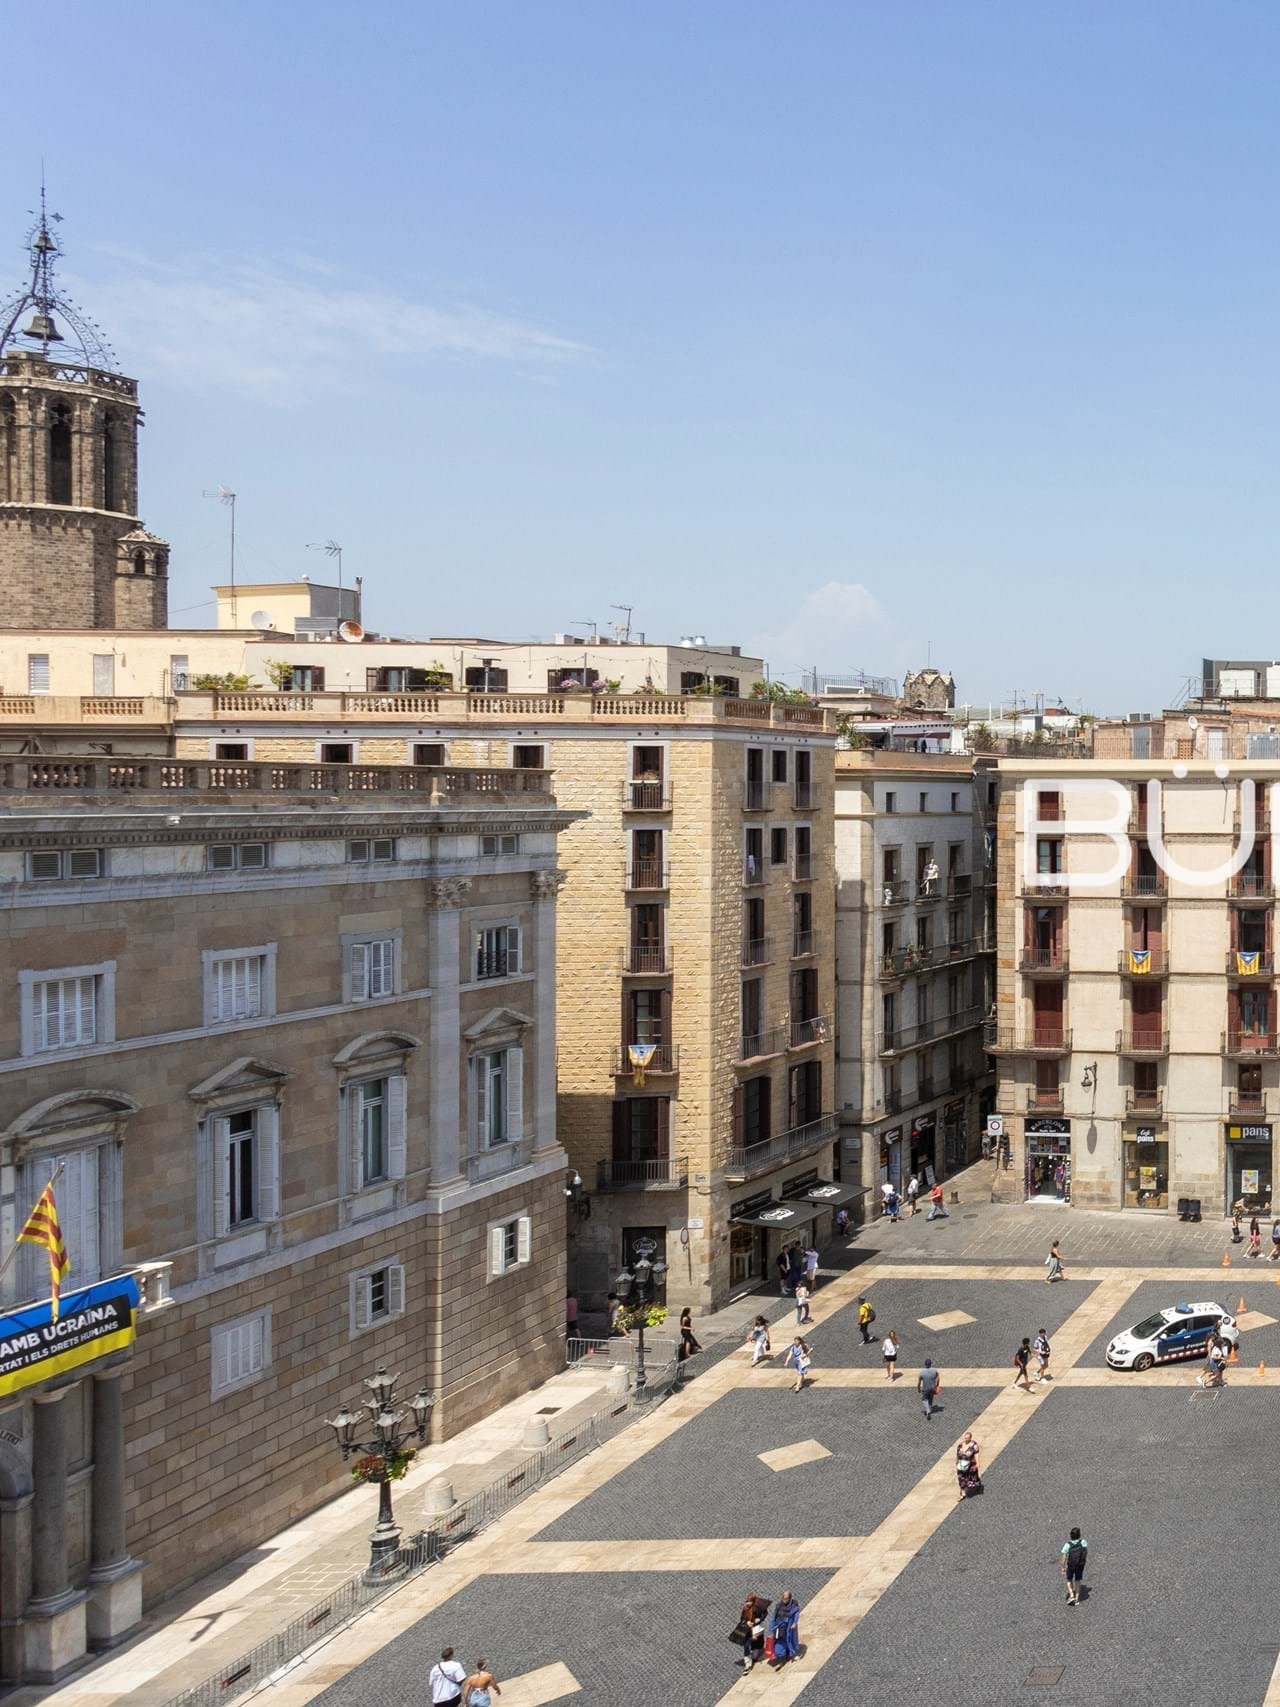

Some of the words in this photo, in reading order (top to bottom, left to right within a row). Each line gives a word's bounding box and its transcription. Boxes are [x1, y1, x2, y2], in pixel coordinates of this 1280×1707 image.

[1242, 1127, 1269, 1138] pans
[0, 1332, 40, 1358] AMB
[43, 1304, 118, 1341] UCRAÏNA
[31, 1348, 49, 1361] ELS
[51, 1334, 79, 1353] DRETS
[80, 1321, 118, 1341] HUMANS
